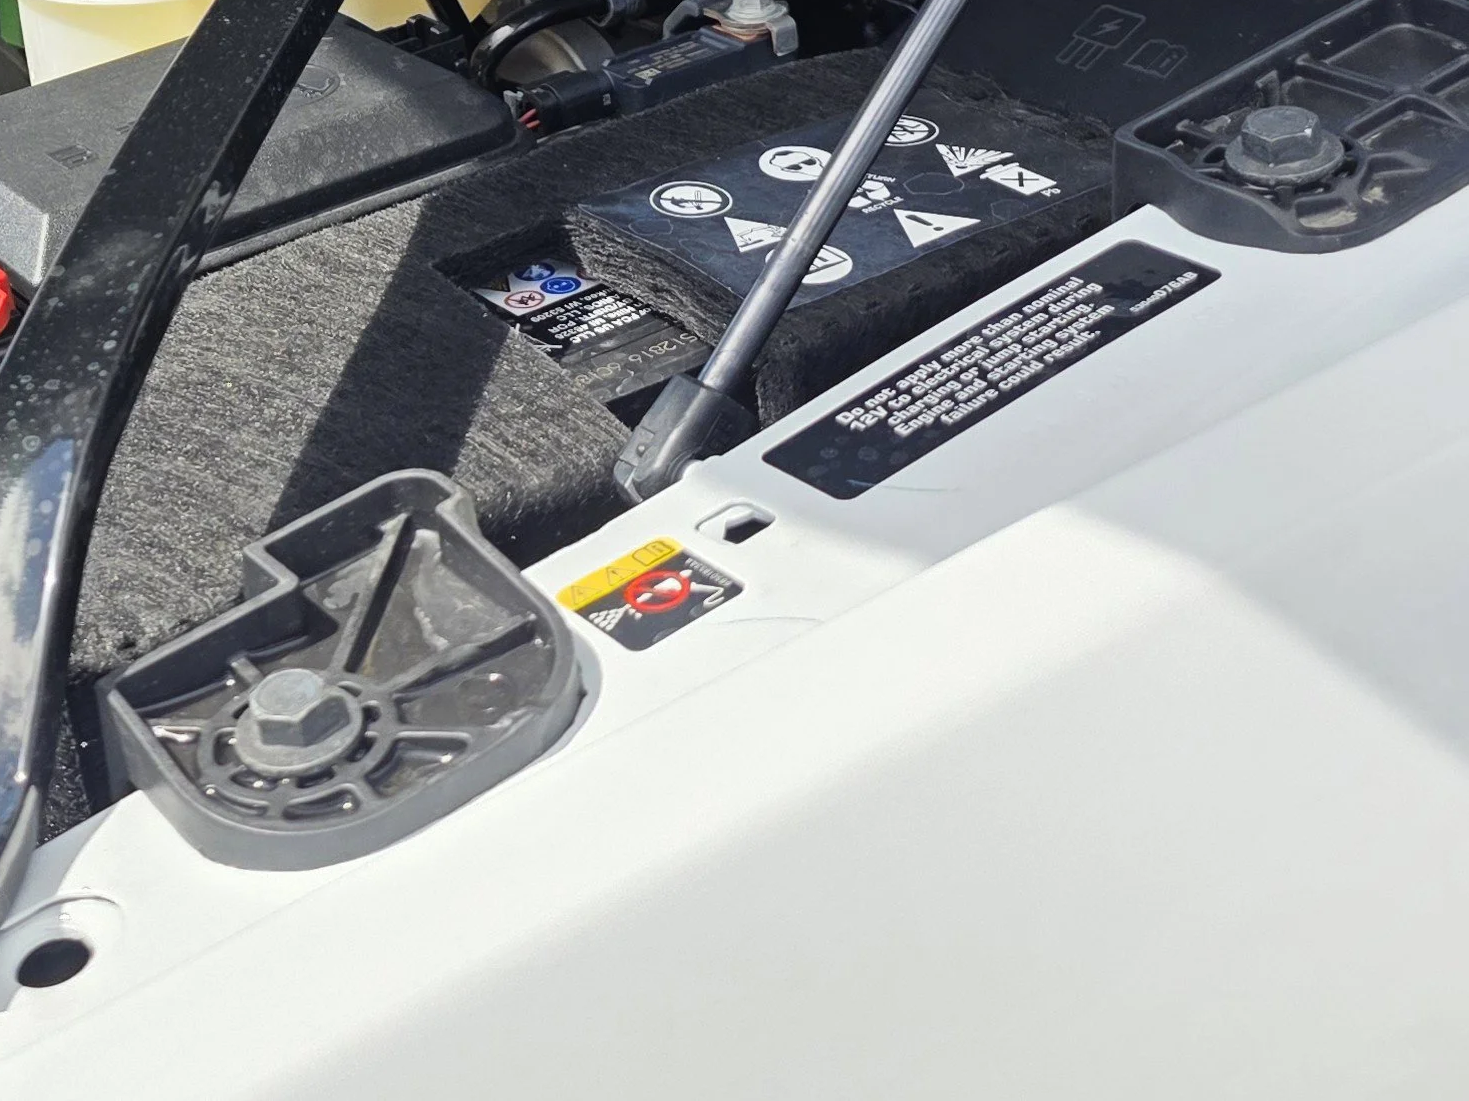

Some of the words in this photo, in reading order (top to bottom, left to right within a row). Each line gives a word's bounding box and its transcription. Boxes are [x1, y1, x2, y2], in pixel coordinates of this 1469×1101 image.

[569, 330, 597, 344] LLC
[835, 406, 865, 426] Do
[865, 387, 897, 409] not
[896, 360, 942, 391] apply
[940, 335, 984, 364] more
[982, 312, 1023, 338] than
[1022, 276, 1084, 314] nominal
[850, 405, 888, 433] 12V
[887, 394, 912, 410] to
[911, 345, 990, 397] electrical
[989, 312, 1049, 348] system
[1048, 282, 1104, 315] during
[887, 379, 963, 427] charging
[959, 366, 979, 384] or
[977, 342, 1023, 372] jump
[893, 399, 955, 438] Engine
[955, 378, 988, 402] and
[987, 338, 1059, 382] starting
[1055, 304, 1115, 342] system
[939, 388, 999, 426] failure
[998, 359, 1045, 392] could
[1043, 330, 1101, 366] result.
